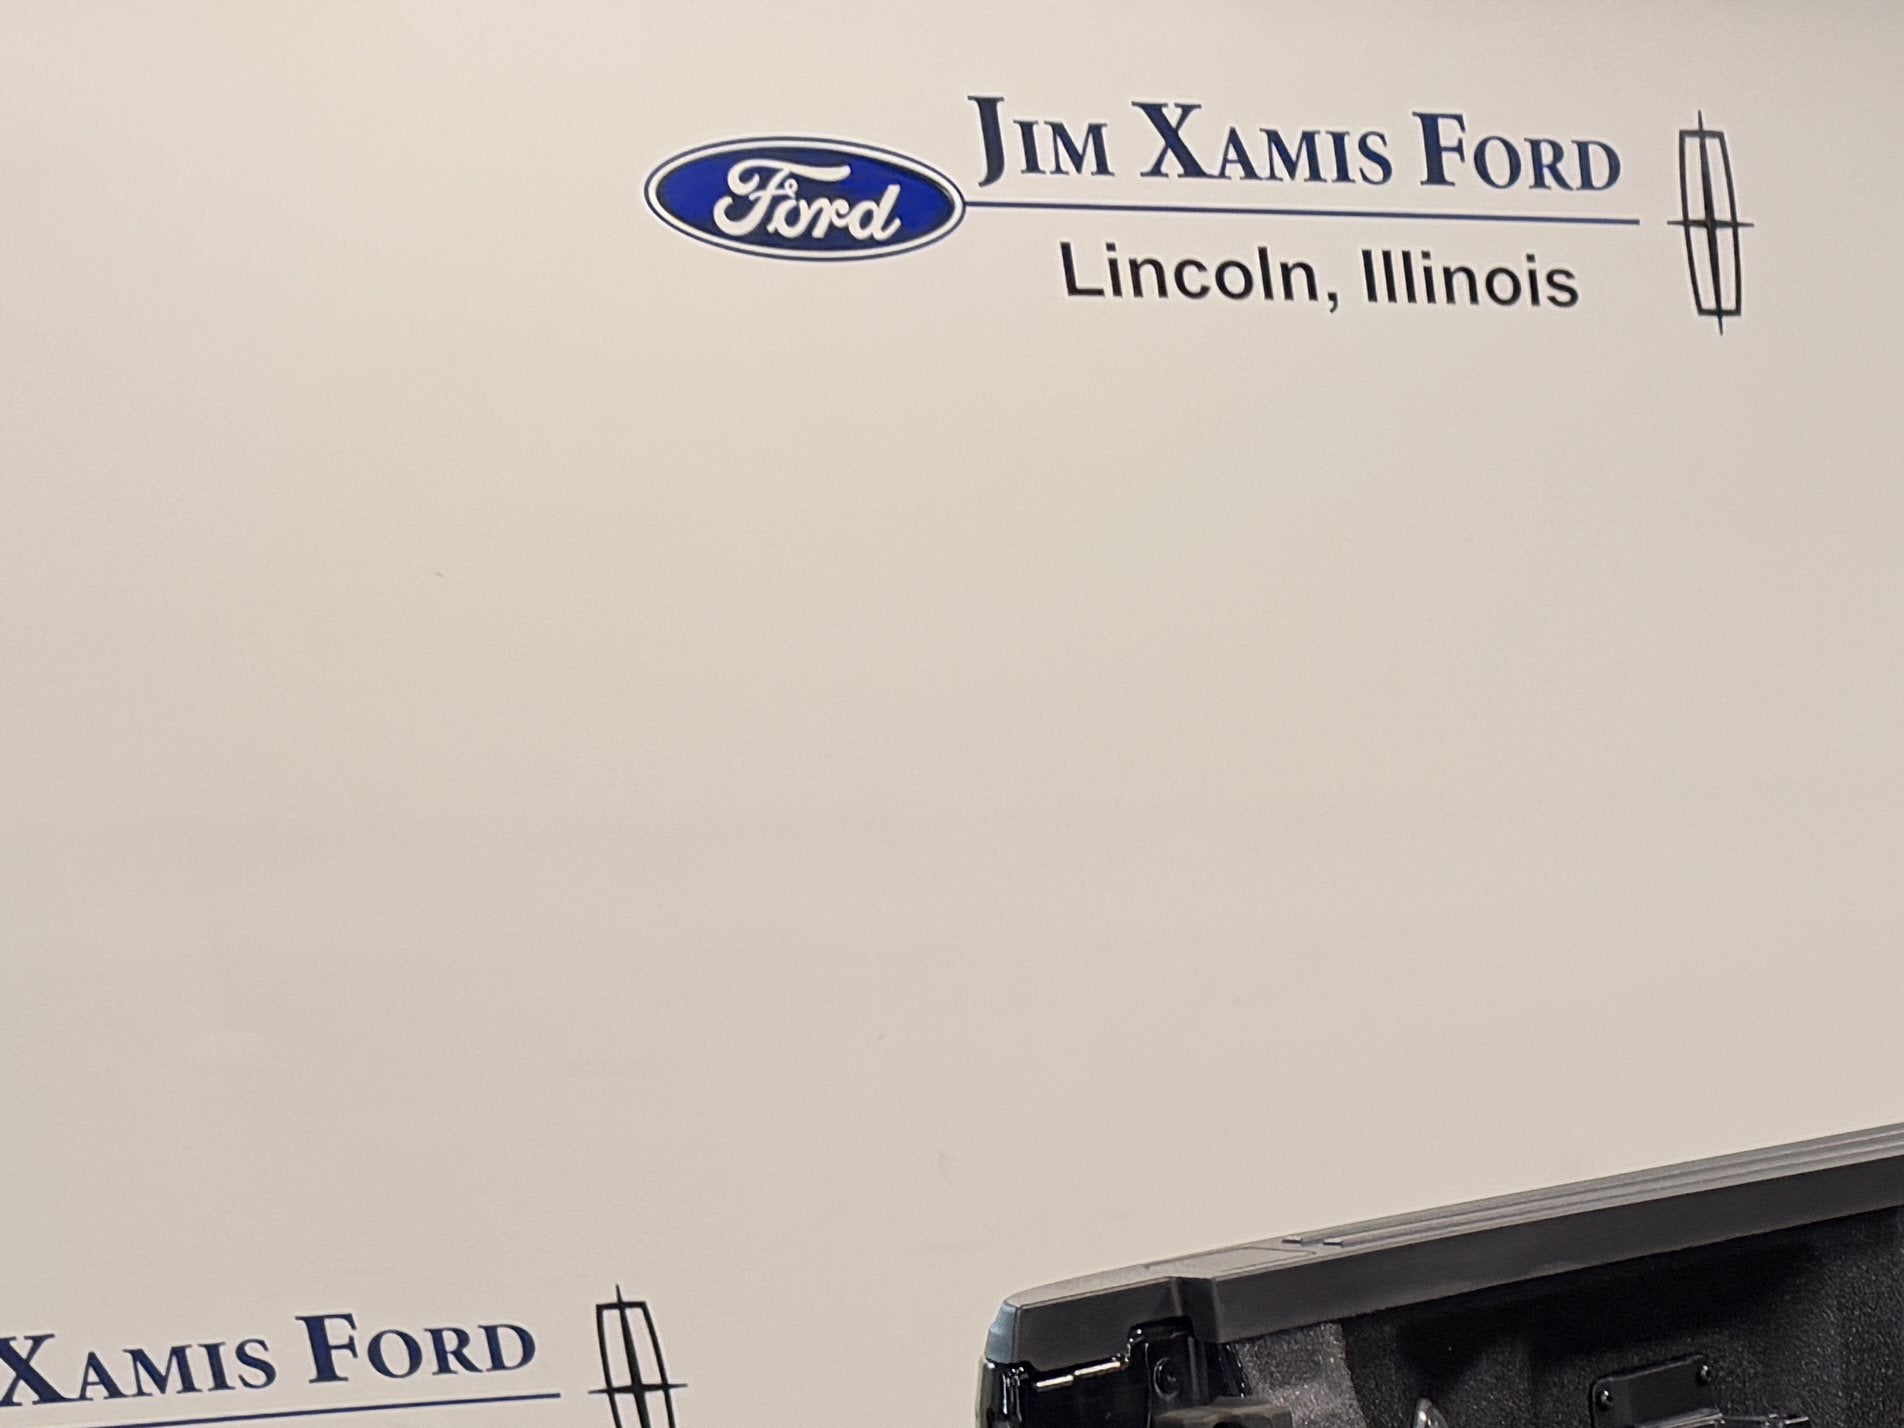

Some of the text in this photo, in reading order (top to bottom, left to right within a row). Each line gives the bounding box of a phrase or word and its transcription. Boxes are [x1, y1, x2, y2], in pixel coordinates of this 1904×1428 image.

[966, 94, 1622, 192] JIM XAMIS FORD
[713, 157, 901, 241] Ford
[1059, 241, 1580, 314] Lincoln, Illinois
[0, 1312, 537, 1409] XAMIS FORD
